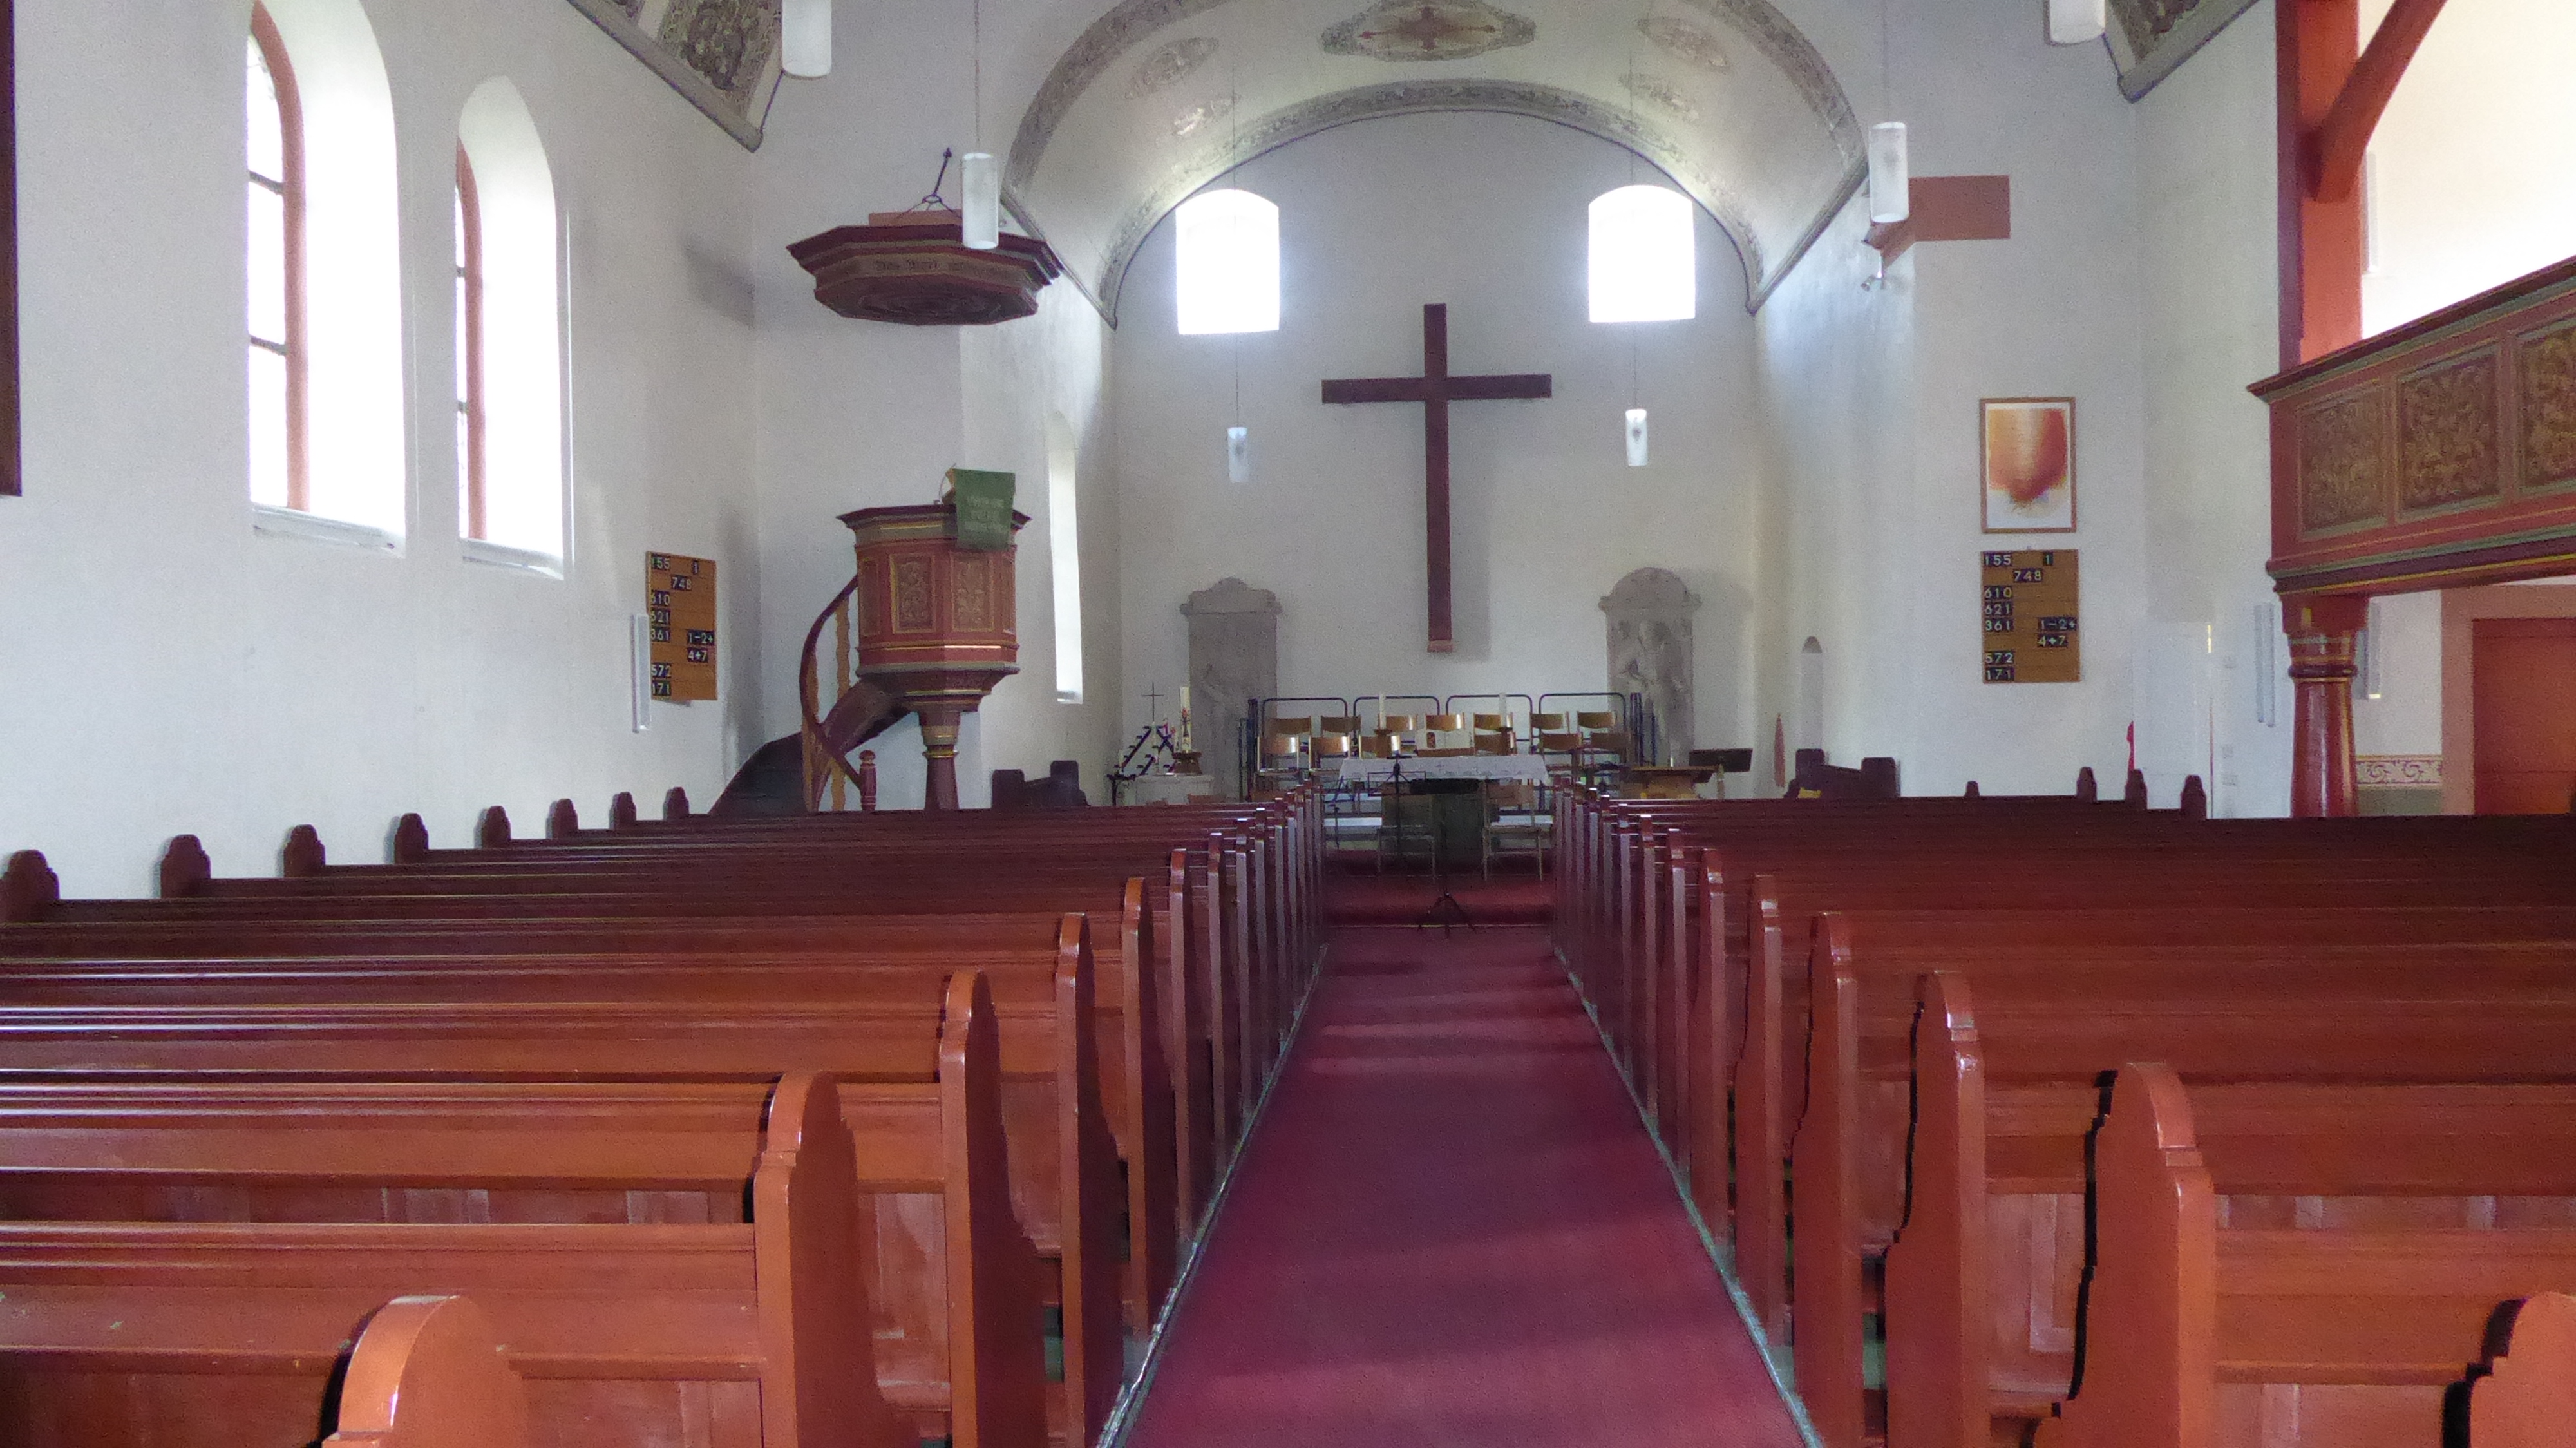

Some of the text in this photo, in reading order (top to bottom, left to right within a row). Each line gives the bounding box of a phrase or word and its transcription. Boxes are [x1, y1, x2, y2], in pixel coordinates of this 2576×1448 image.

[1984, 554, 2050, 565] 155 1
[694, 562, 698, 573] 1
[2013, 570, 2041, 582] 748
[1984, 587, 2012, 598] 610
[1984, 604, 2010, 615] 621
[1985, 620, 2011, 631] 361
[650, 629, 669, 641] 361
[1985, 653, 2013, 663] 572
[650, 664, 672, 677] 572
[1986, 669, 2012, 680] 171
[652, 683, 670, 694] 171
